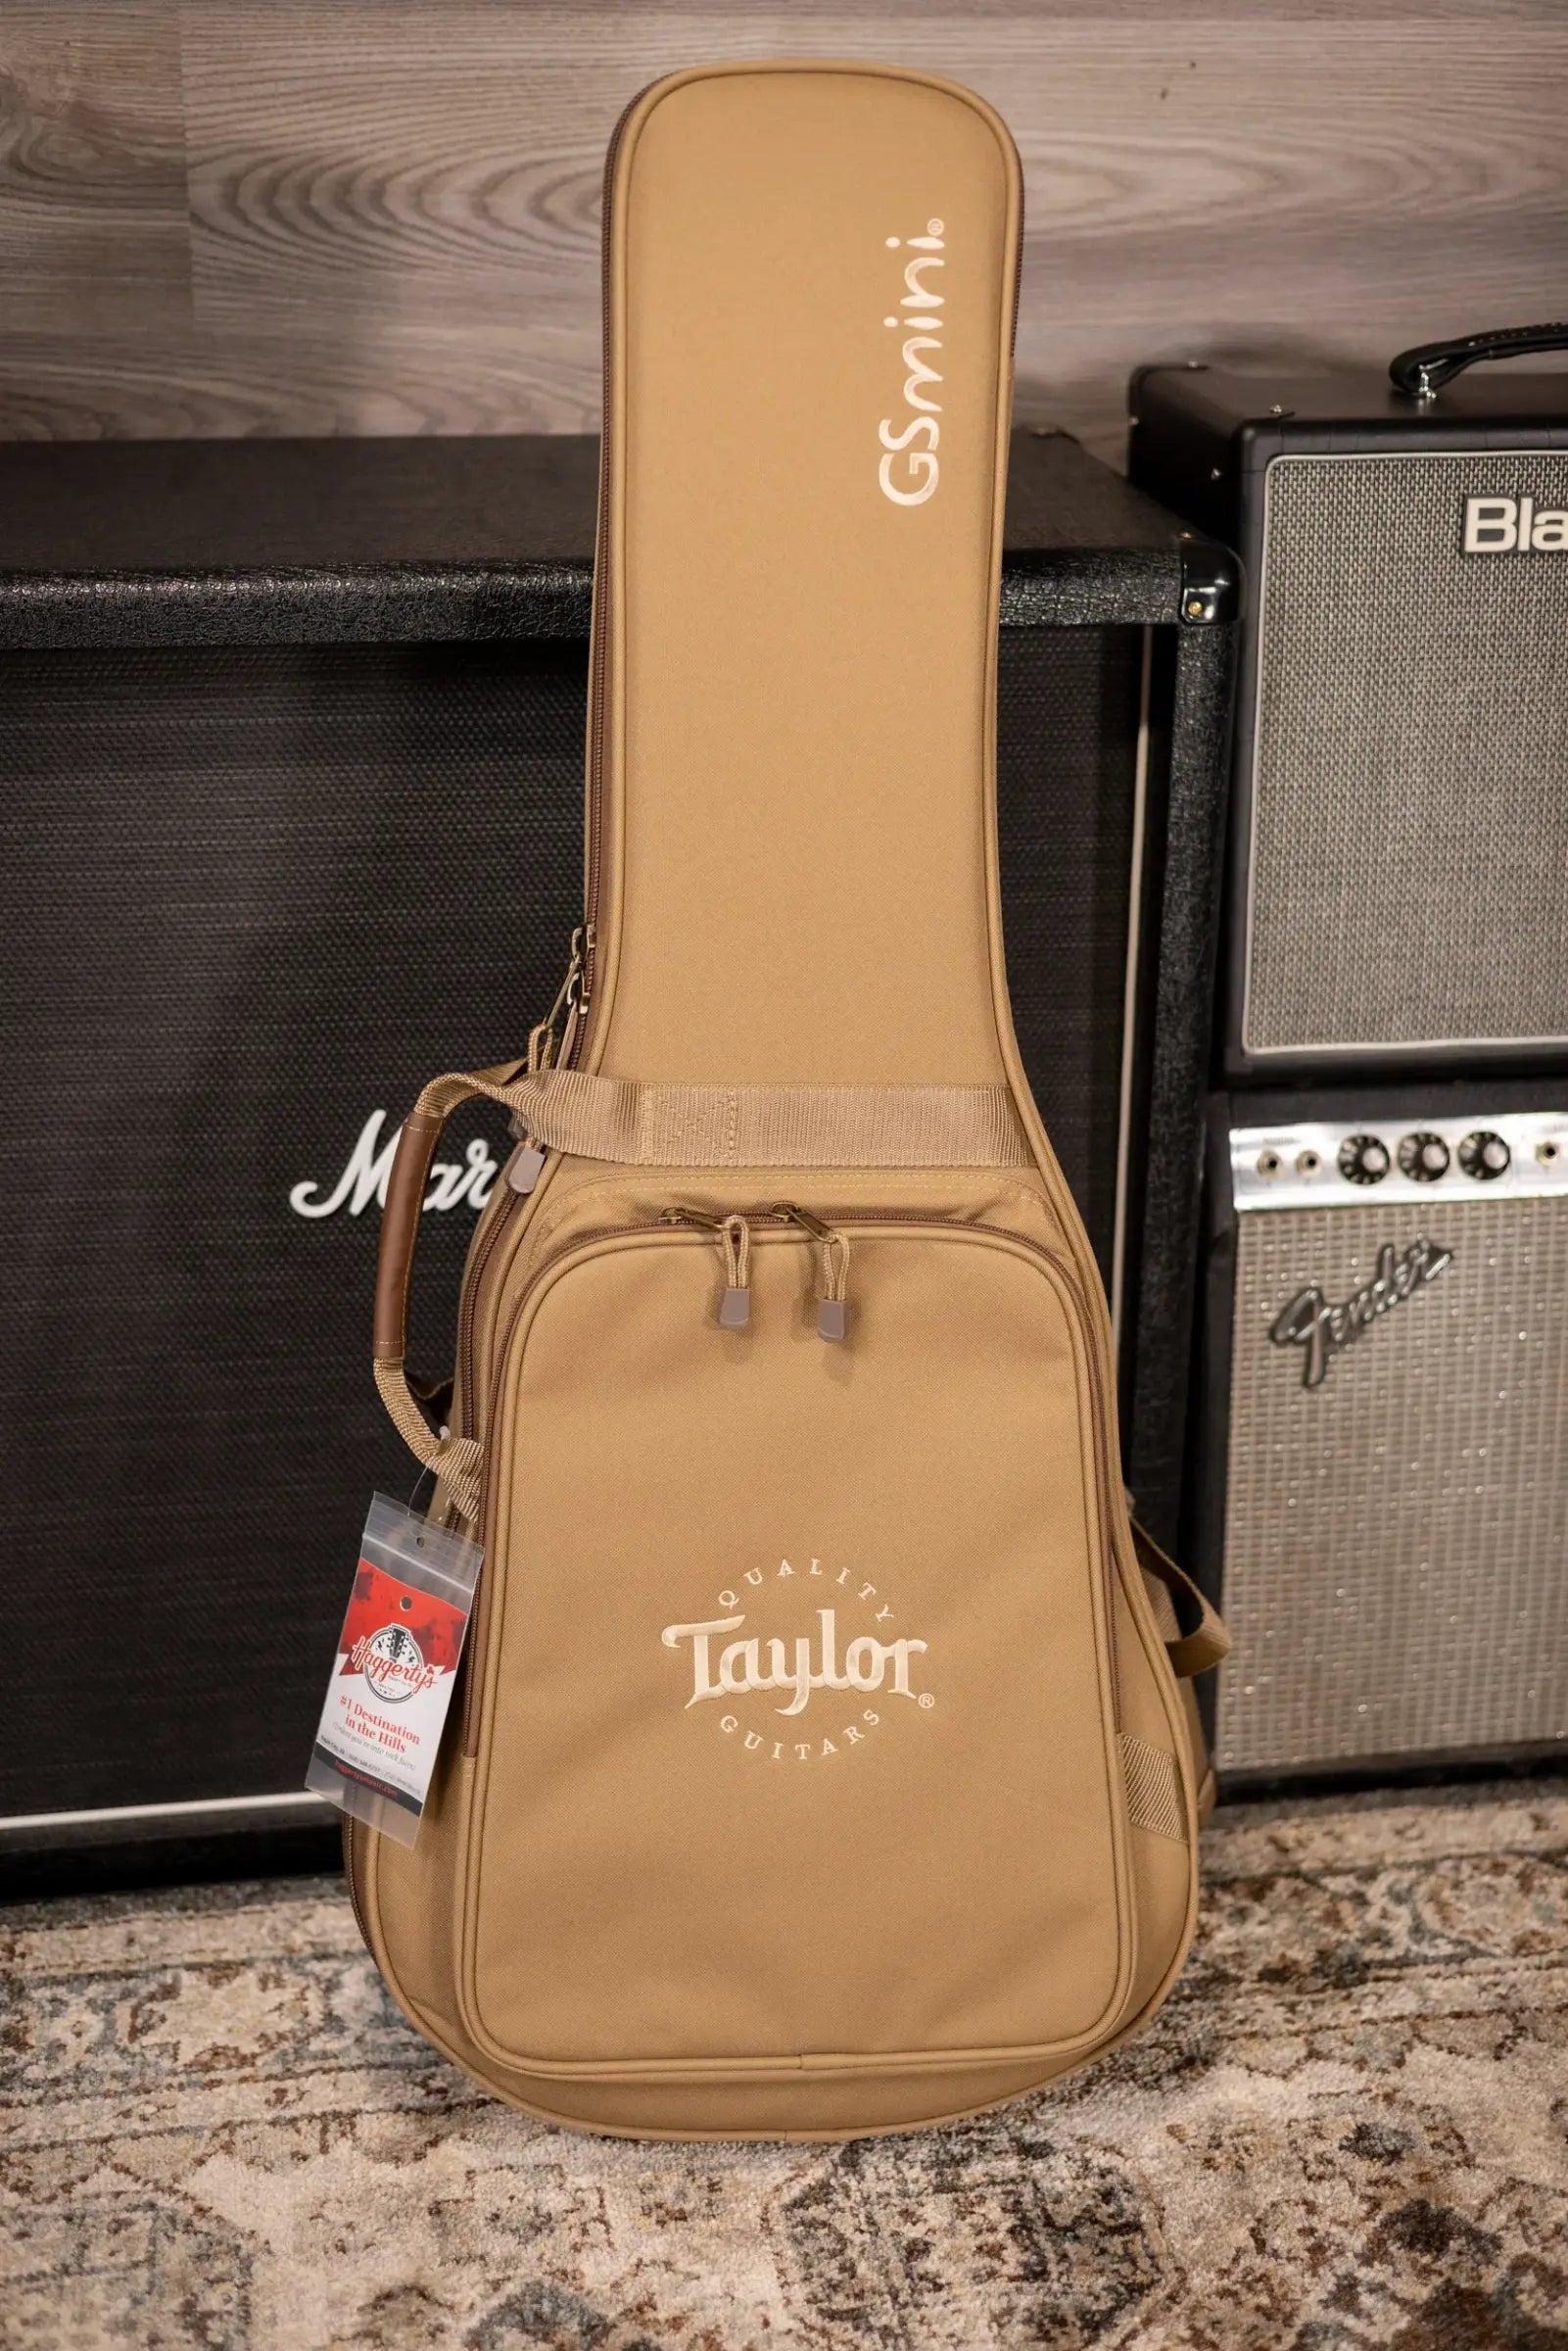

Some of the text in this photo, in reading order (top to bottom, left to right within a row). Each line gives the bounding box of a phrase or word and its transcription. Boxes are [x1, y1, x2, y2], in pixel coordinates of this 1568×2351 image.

[1464, 497, 1568, 552] Bla
[718, 1559, 894, 1622] QUALITY
[352, 1635, 437, 1695] Haggerty's
[661, 1608, 928, 1716] Taylor
[340, 1695, 420, 1745] #1 Destination
[345, 1714, 406, 1753] in the Hills
[720, 1708, 880, 1760] GUITARS
